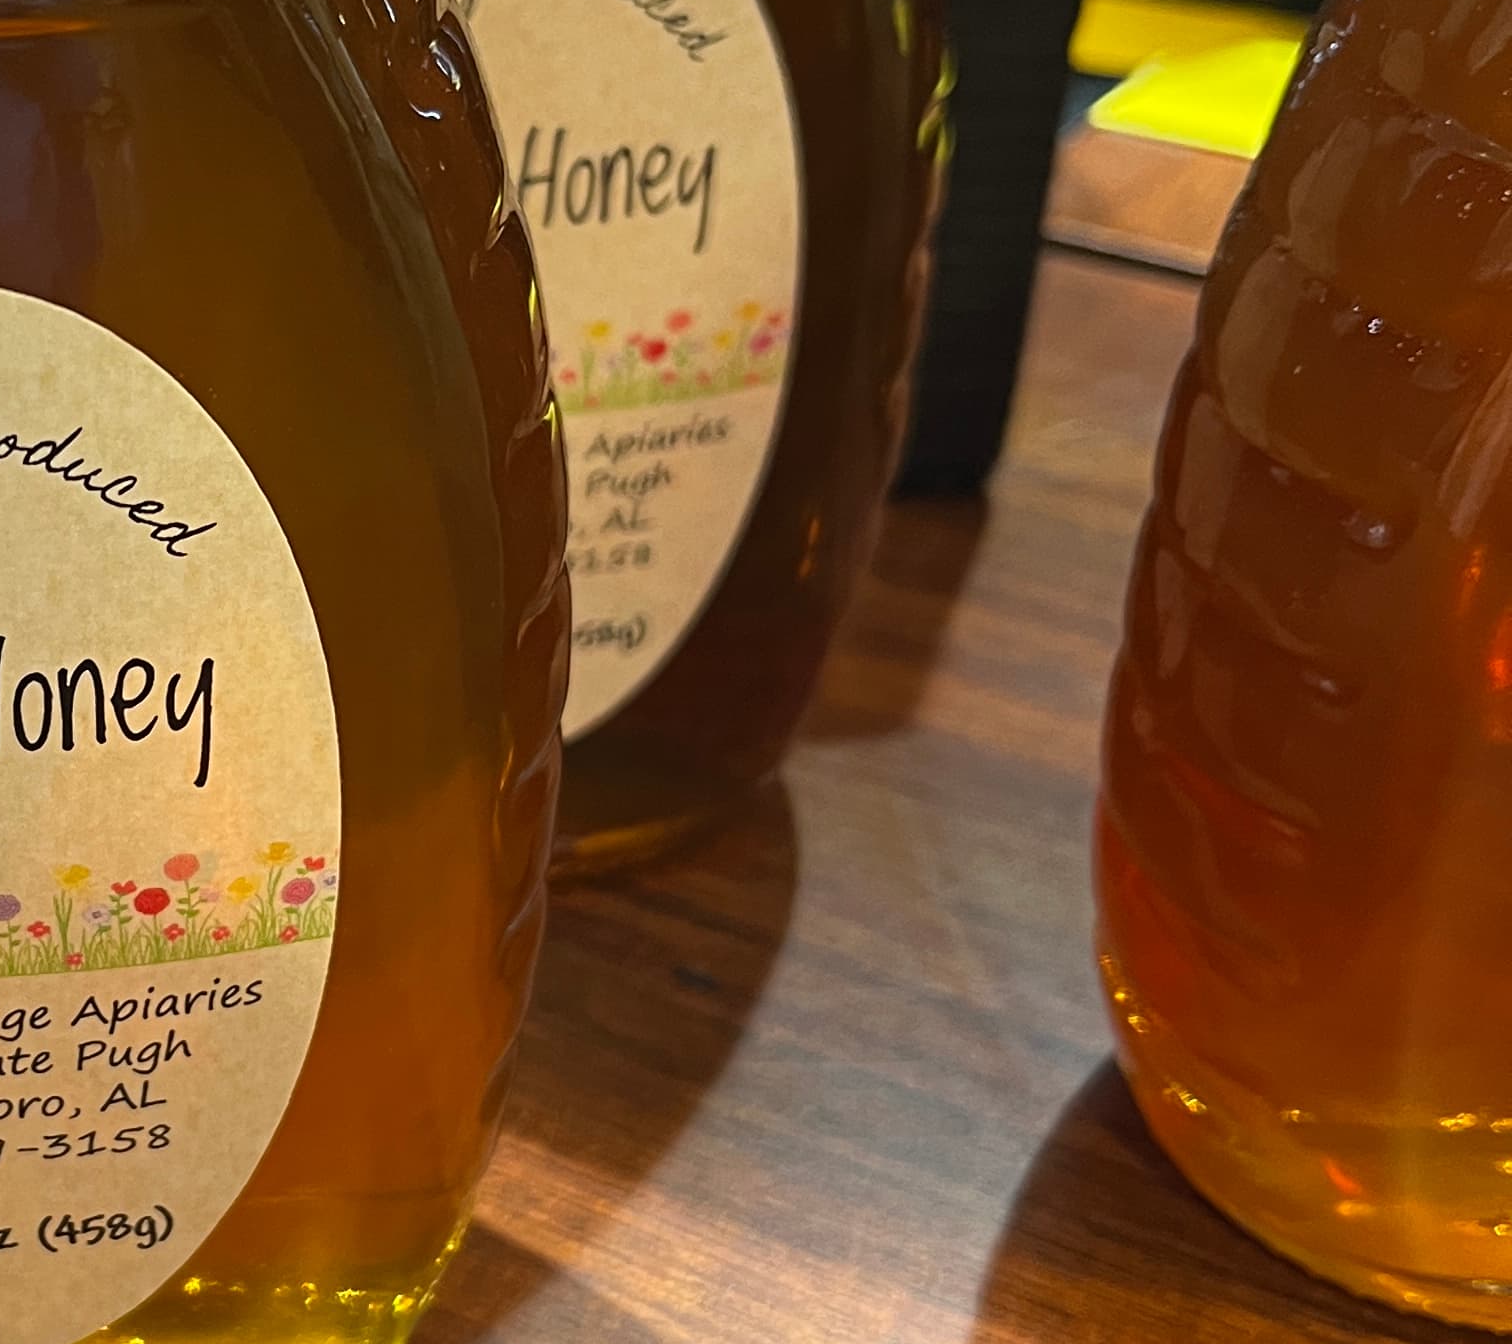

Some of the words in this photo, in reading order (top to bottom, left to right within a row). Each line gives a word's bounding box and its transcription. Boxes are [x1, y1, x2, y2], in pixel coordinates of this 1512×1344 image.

[517, 125, 716, 256] Honey
[71, 975, 264, 1036] Apiaries
[76, 1030, 193, 1078] Pugh
[99, 1079, 169, 1113] AL
[36, 1204, 176, 1253] (458g)
